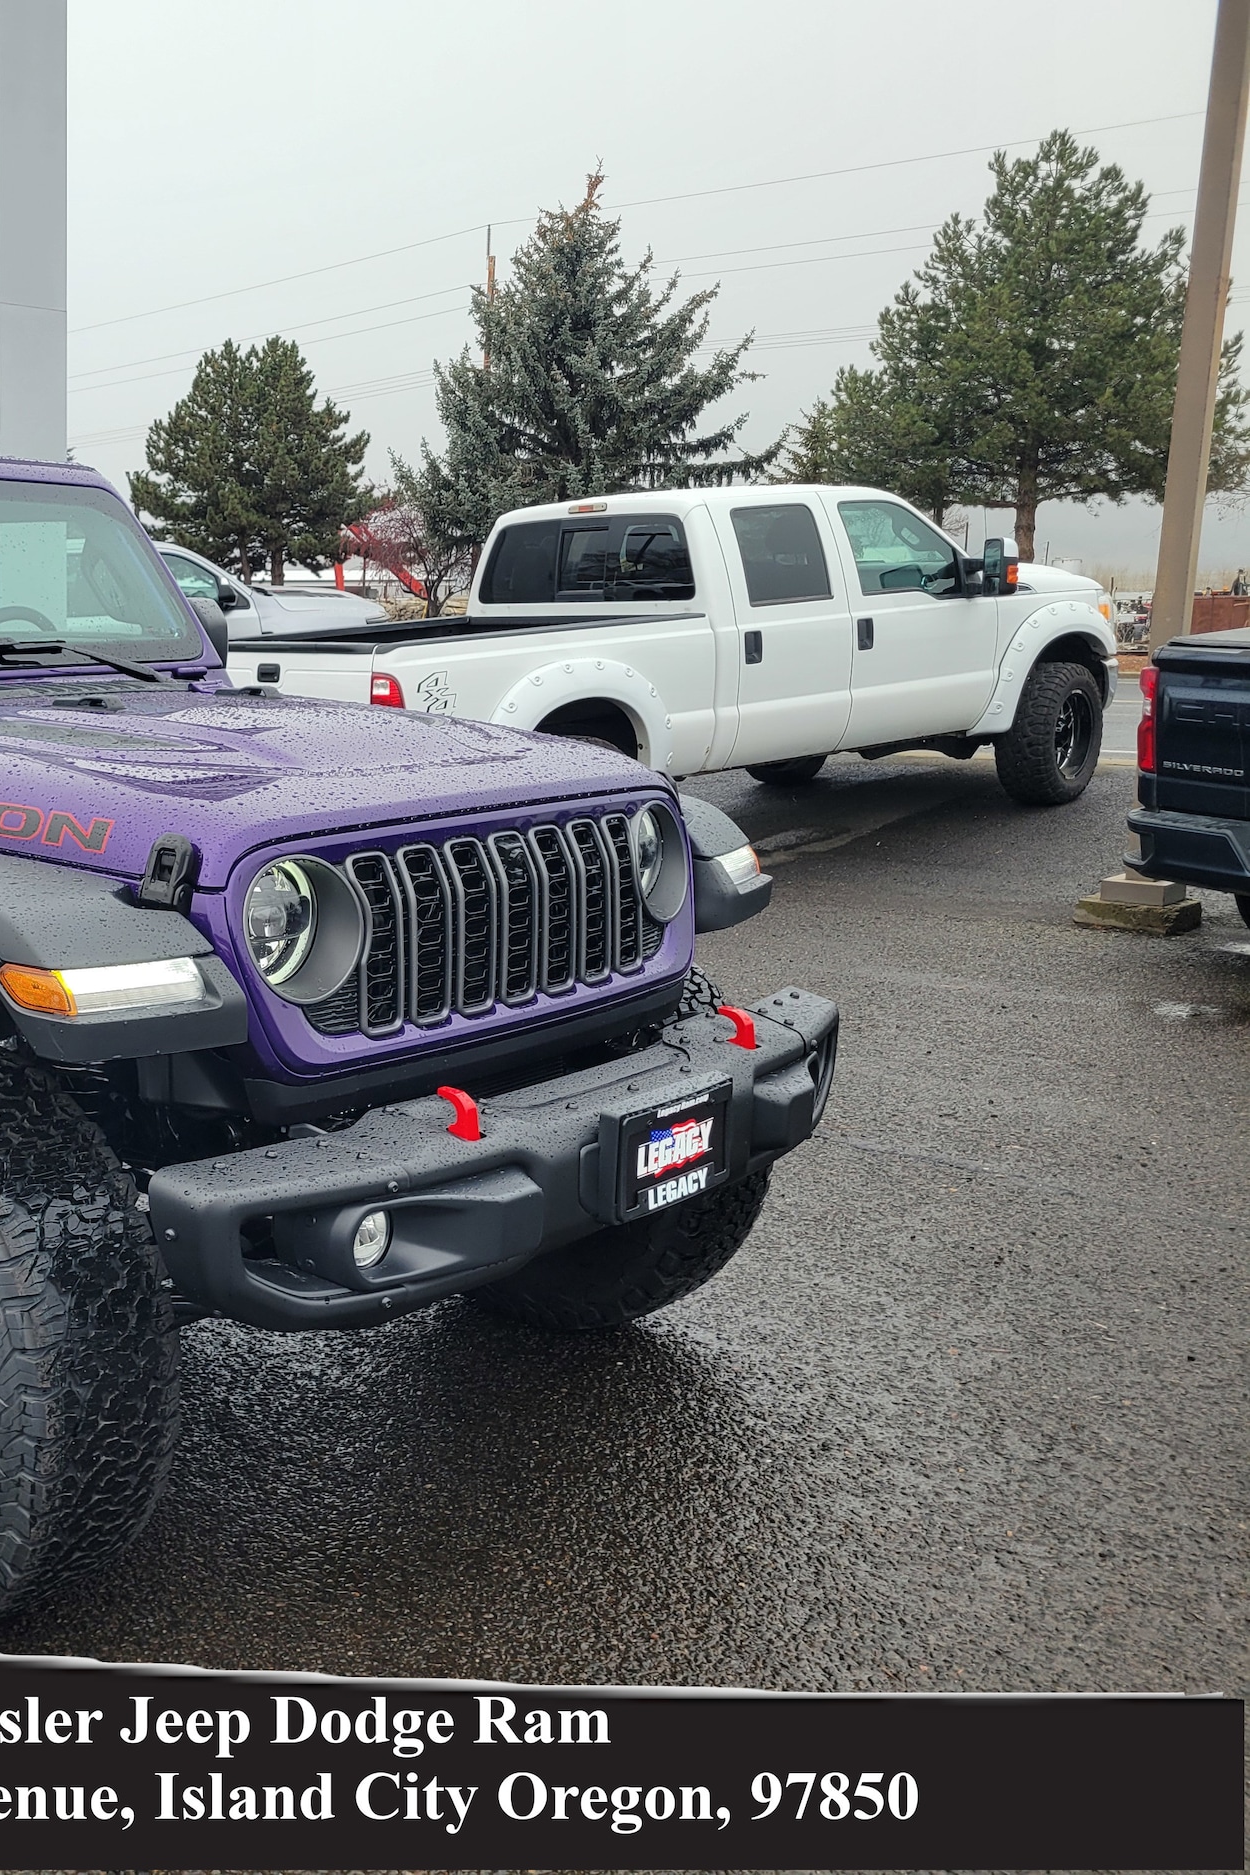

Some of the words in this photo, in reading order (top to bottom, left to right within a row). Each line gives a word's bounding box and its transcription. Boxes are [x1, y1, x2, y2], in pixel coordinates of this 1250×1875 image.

[1162, 760, 1245, 778] SILVERADO
[637, 1119, 714, 1177] LEGACY
[648, 1167, 709, 1210] LEGACY
